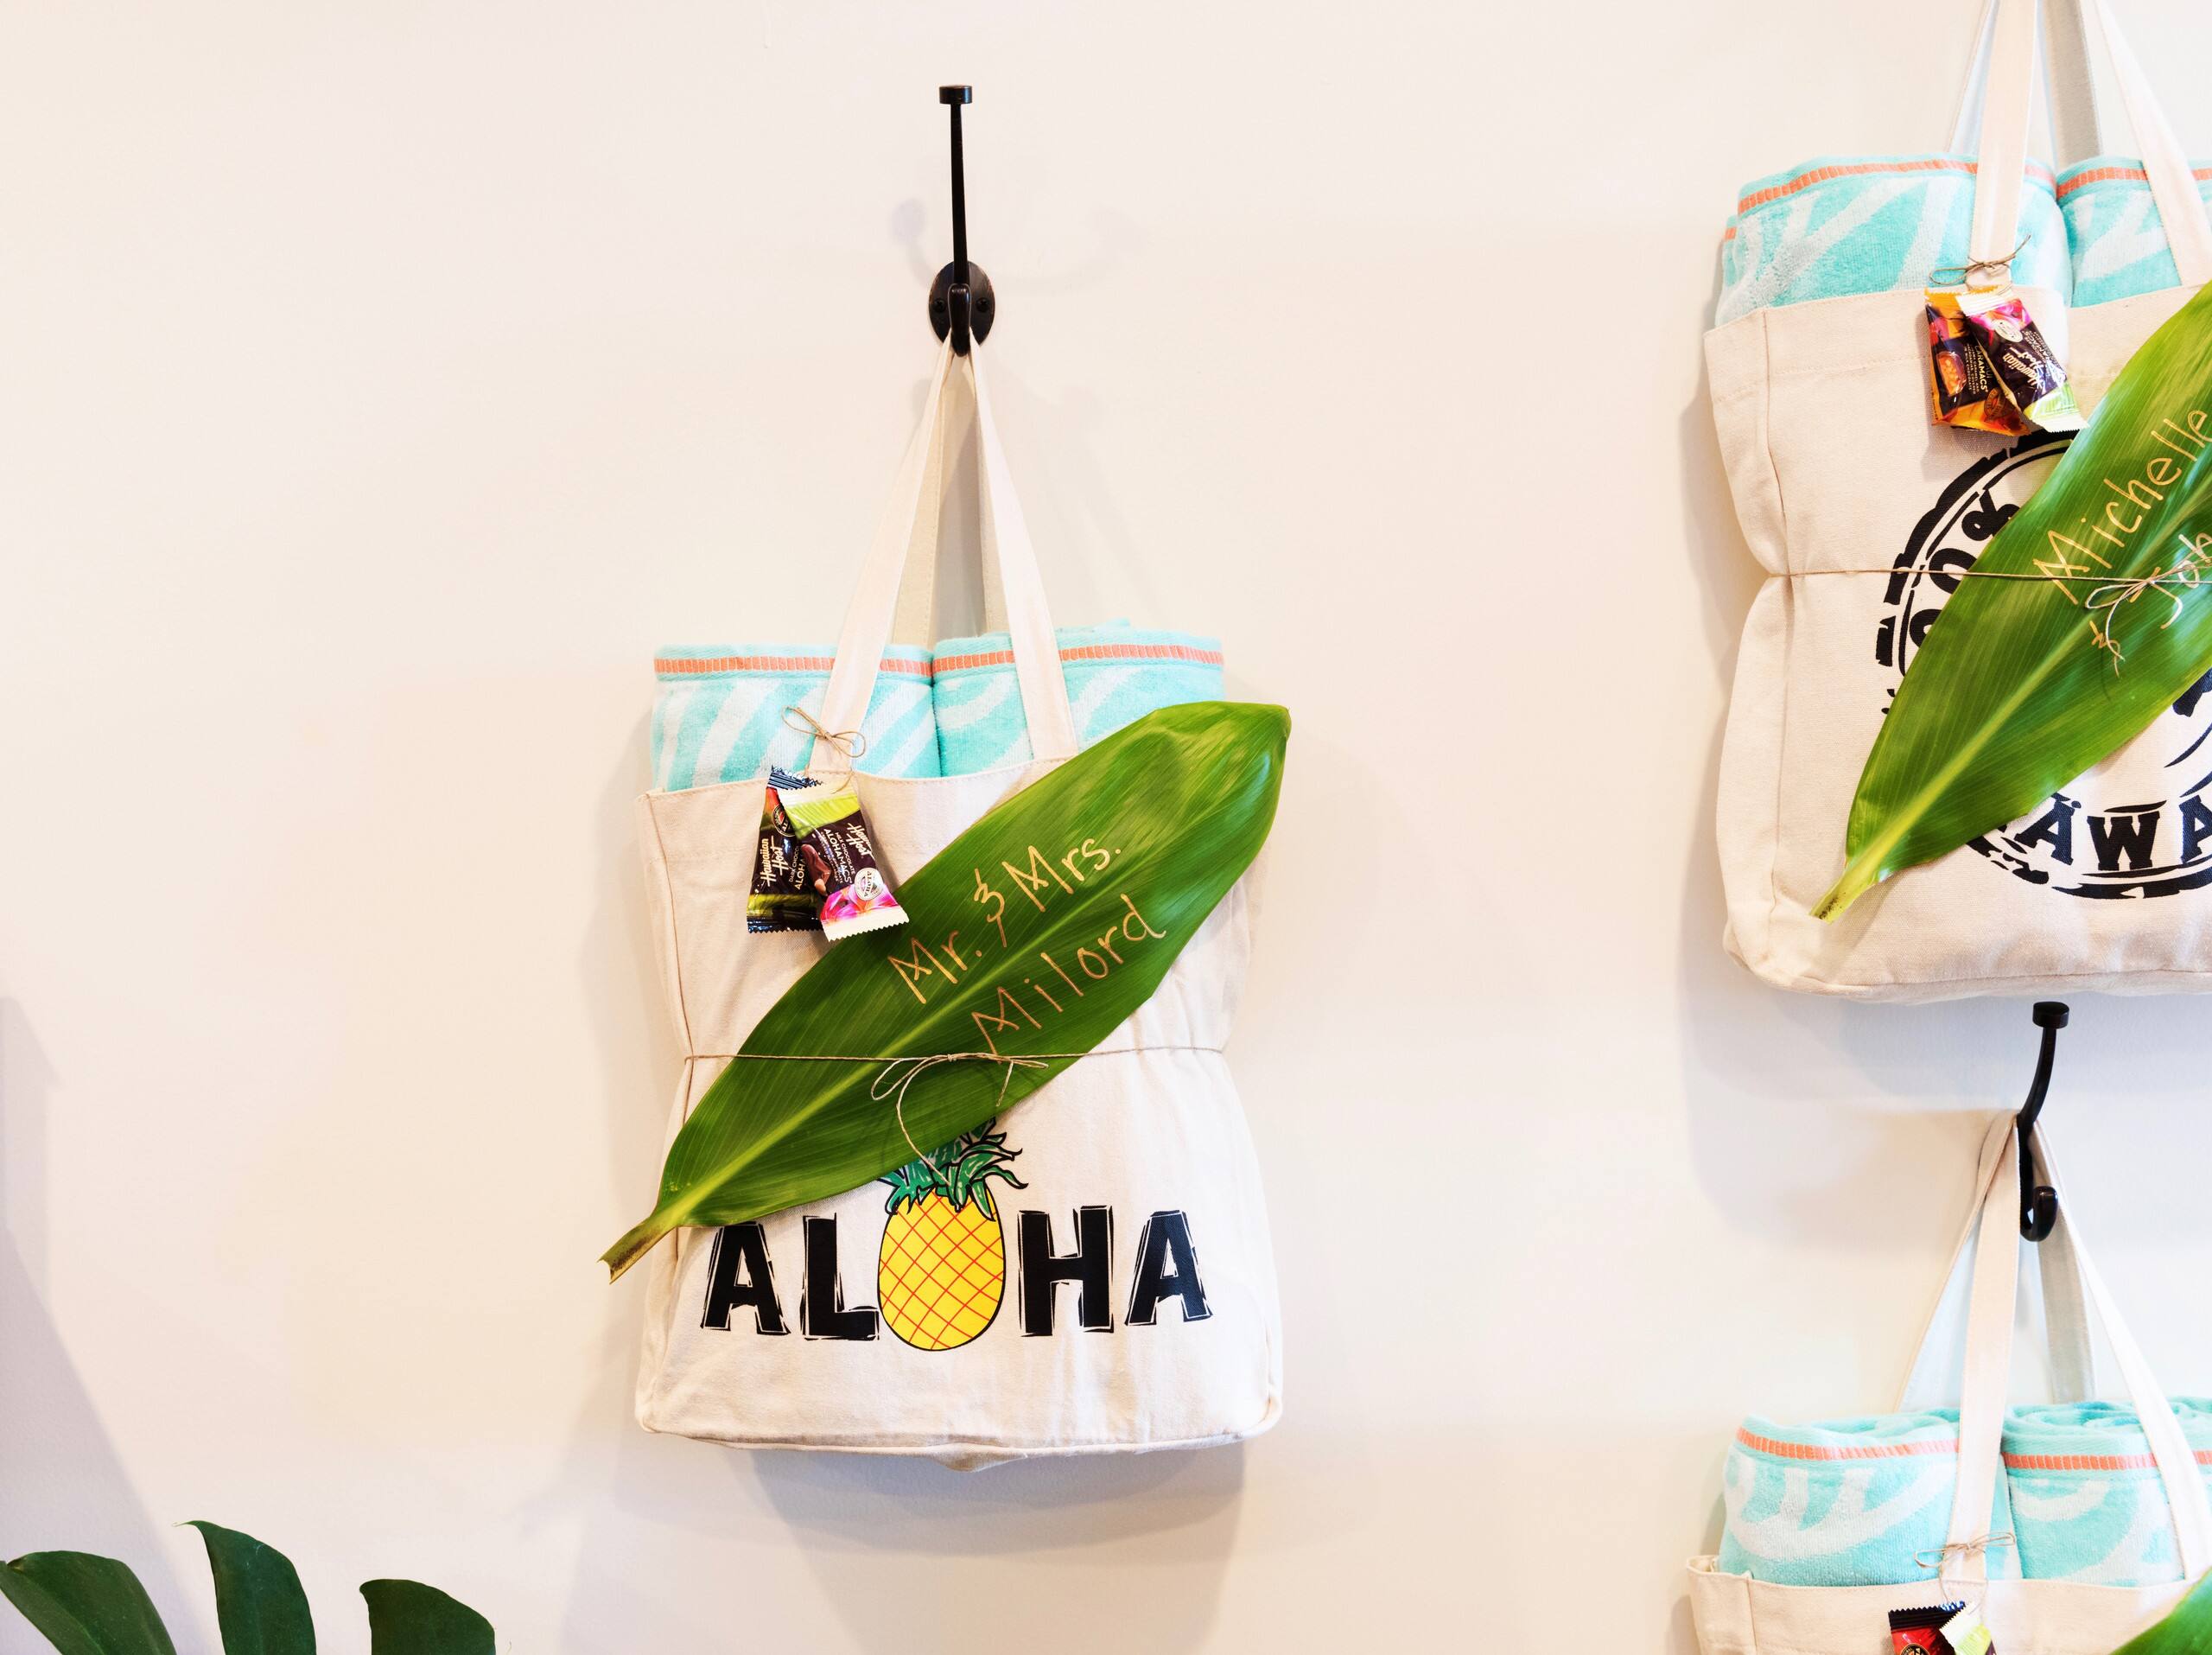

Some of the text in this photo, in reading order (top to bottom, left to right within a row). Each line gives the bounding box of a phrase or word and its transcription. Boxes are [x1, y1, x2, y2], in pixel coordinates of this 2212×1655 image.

[2010, 347, 2046, 375] Host
[2033, 410, 2212, 604] Michelle
[760, 837, 777, 888] Hawaiian
[771, 835, 790, 876] Host
[835, 831, 855, 875] MILK CHOCOLATE
[847, 833, 874, 856] Host
[887, 929, 983, 1004] Mr.
[1001, 838, 1122, 913] Mrs.
[970, 893, 1167, 1065] Milord
